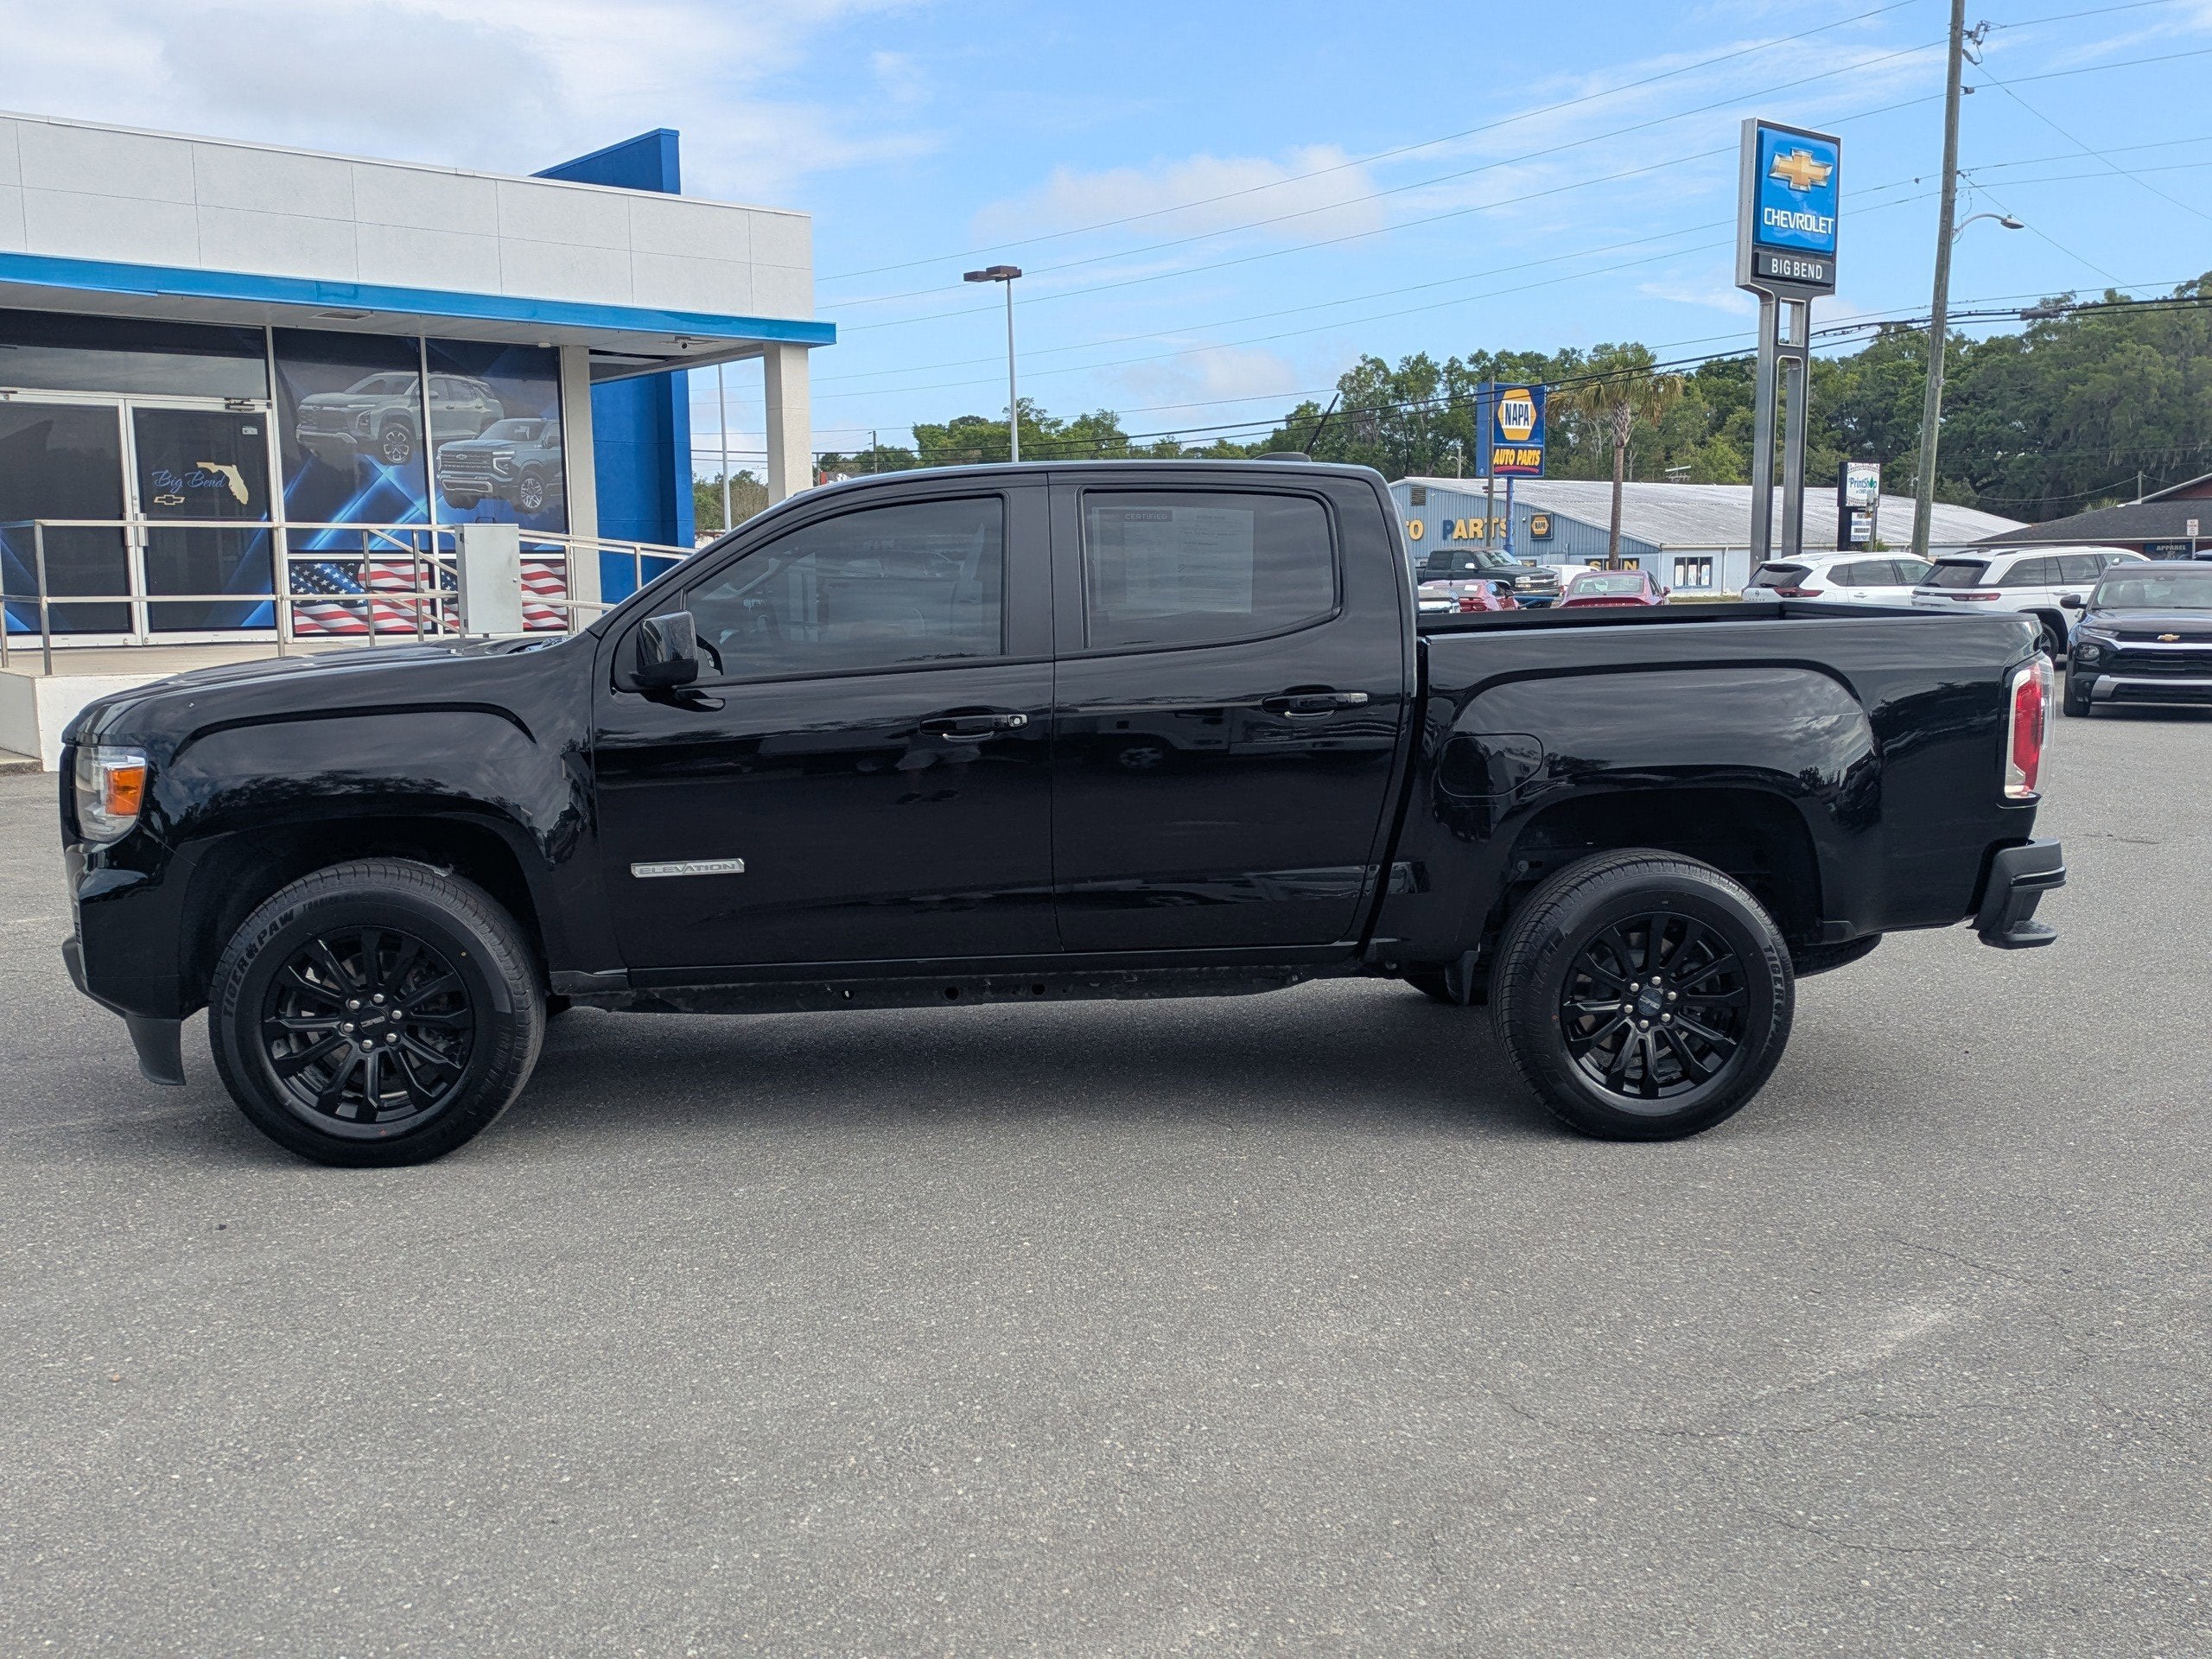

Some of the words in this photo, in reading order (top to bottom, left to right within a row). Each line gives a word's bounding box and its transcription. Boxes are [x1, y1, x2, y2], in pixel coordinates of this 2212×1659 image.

[1764, 207, 1834, 234] CHEVROLET
[1771, 257, 1791, 275] BIG
[1793, 261, 1822, 280] BEND
[1504, 403, 1529, 426] NAPA
[1493, 448, 1516, 465] AUTO
[1516, 449, 1541, 466] PARTS
[151, 469, 183, 493] Big
[185, 470, 226, 488] Bend
[639, 863, 734, 875] ELEVATION
[221, 956, 250, 1018] TIGER
[257, 908, 294, 947] PAW
